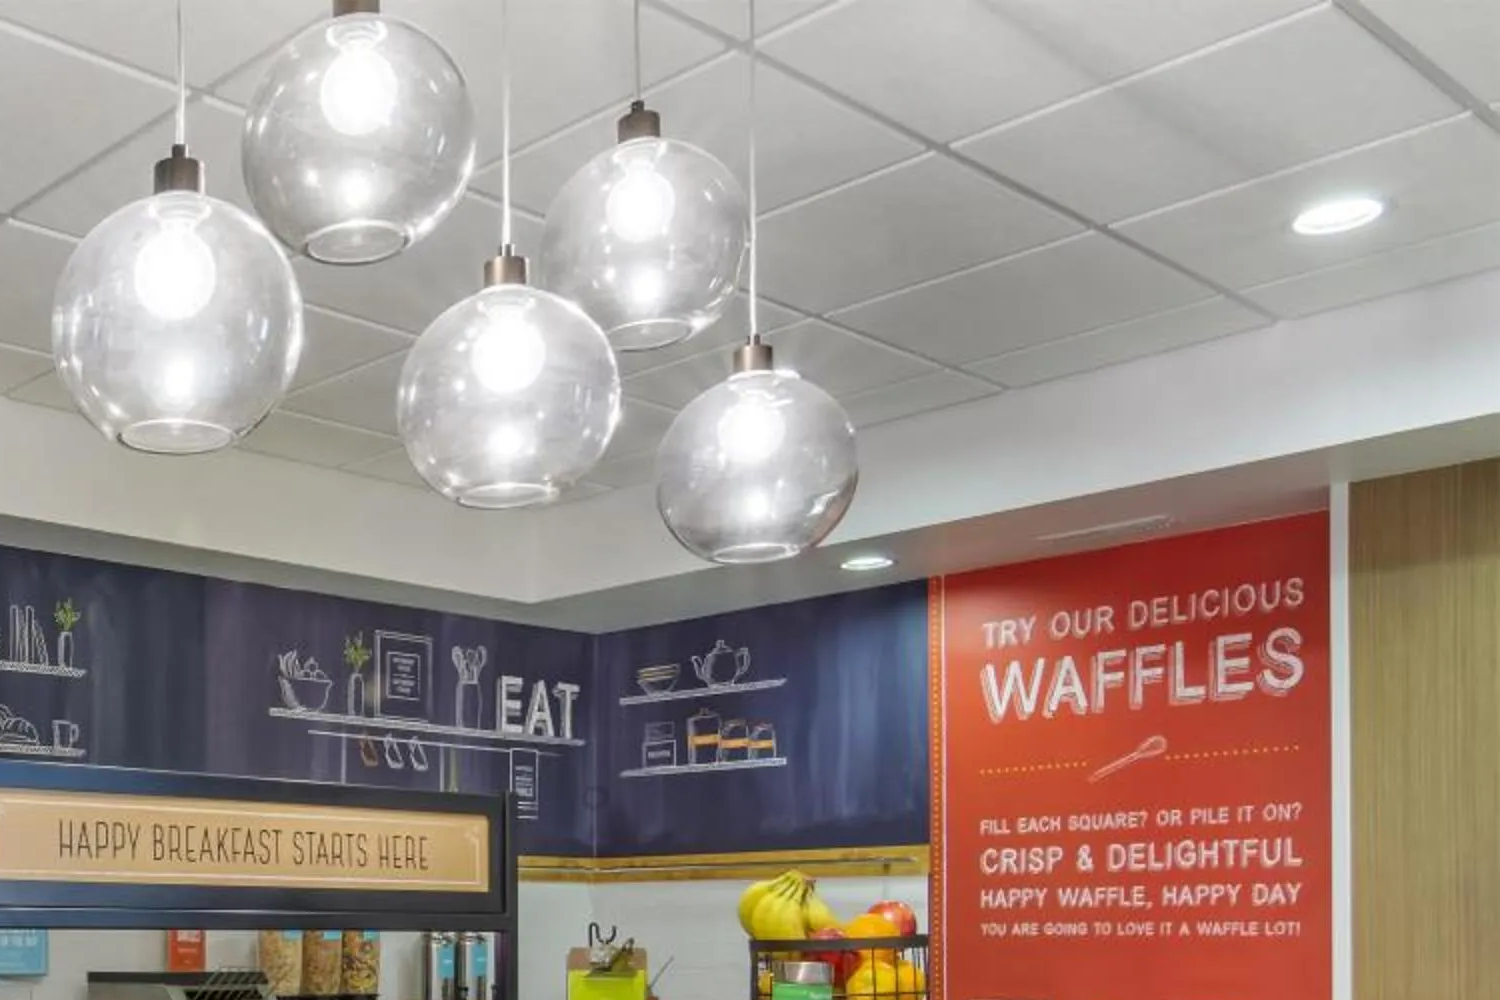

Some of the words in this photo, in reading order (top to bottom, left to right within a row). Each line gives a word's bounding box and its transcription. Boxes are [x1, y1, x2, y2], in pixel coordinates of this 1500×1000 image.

[982, 616, 1036, 649] TRY
[1051, 606, 1114, 639] OUR
[1128, 577, 1304, 629] DELICIOUS
[980, 627, 1304, 724] WAFFLES
[497, 675, 581, 740] EAT
[981, 819, 1010, 836] FILL
[1017, 816, 1061, 833] EACH
[1069, 812, 1148, 831] SQUARE?
[1156, 810, 1181, 826] OR
[1191, 807, 1228, 824] PILE
[1237, 805, 1253, 822] IT
[1263, 802, 1302, 821] ON?
[59, 819, 141, 860] HAPPY
[153, 823, 282, 865] BREAKFAST
[292, 831, 368, 868] STARTS
[378, 834, 429, 870] HERE
[981, 847, 1063, 875] CRISP
[1076, 845, 1095, 872] &
[1107, 838, 1303, 872] DELIGHTFUL
[981, 888, 1047, 908] HAPPY
[1058, 886, 1153, 909] WAFFLE,
[1162, 884, 1241, 907] HAPPY
[1252, 882, 1302, 906] DAY
[981, 922, 1006, 936] YOU
[1012, 922, 1038, 936] ARE
[1044, 922, 1088, 936] GOING
[1094, 922, 1111, 936] TO
[1117, 922, 1154, 936] LOVE
[1160, 922, 1173, 936] IT
[1179, 922, 1190, 936] A
[1197, 922, 1259, 936] WAFFLE
